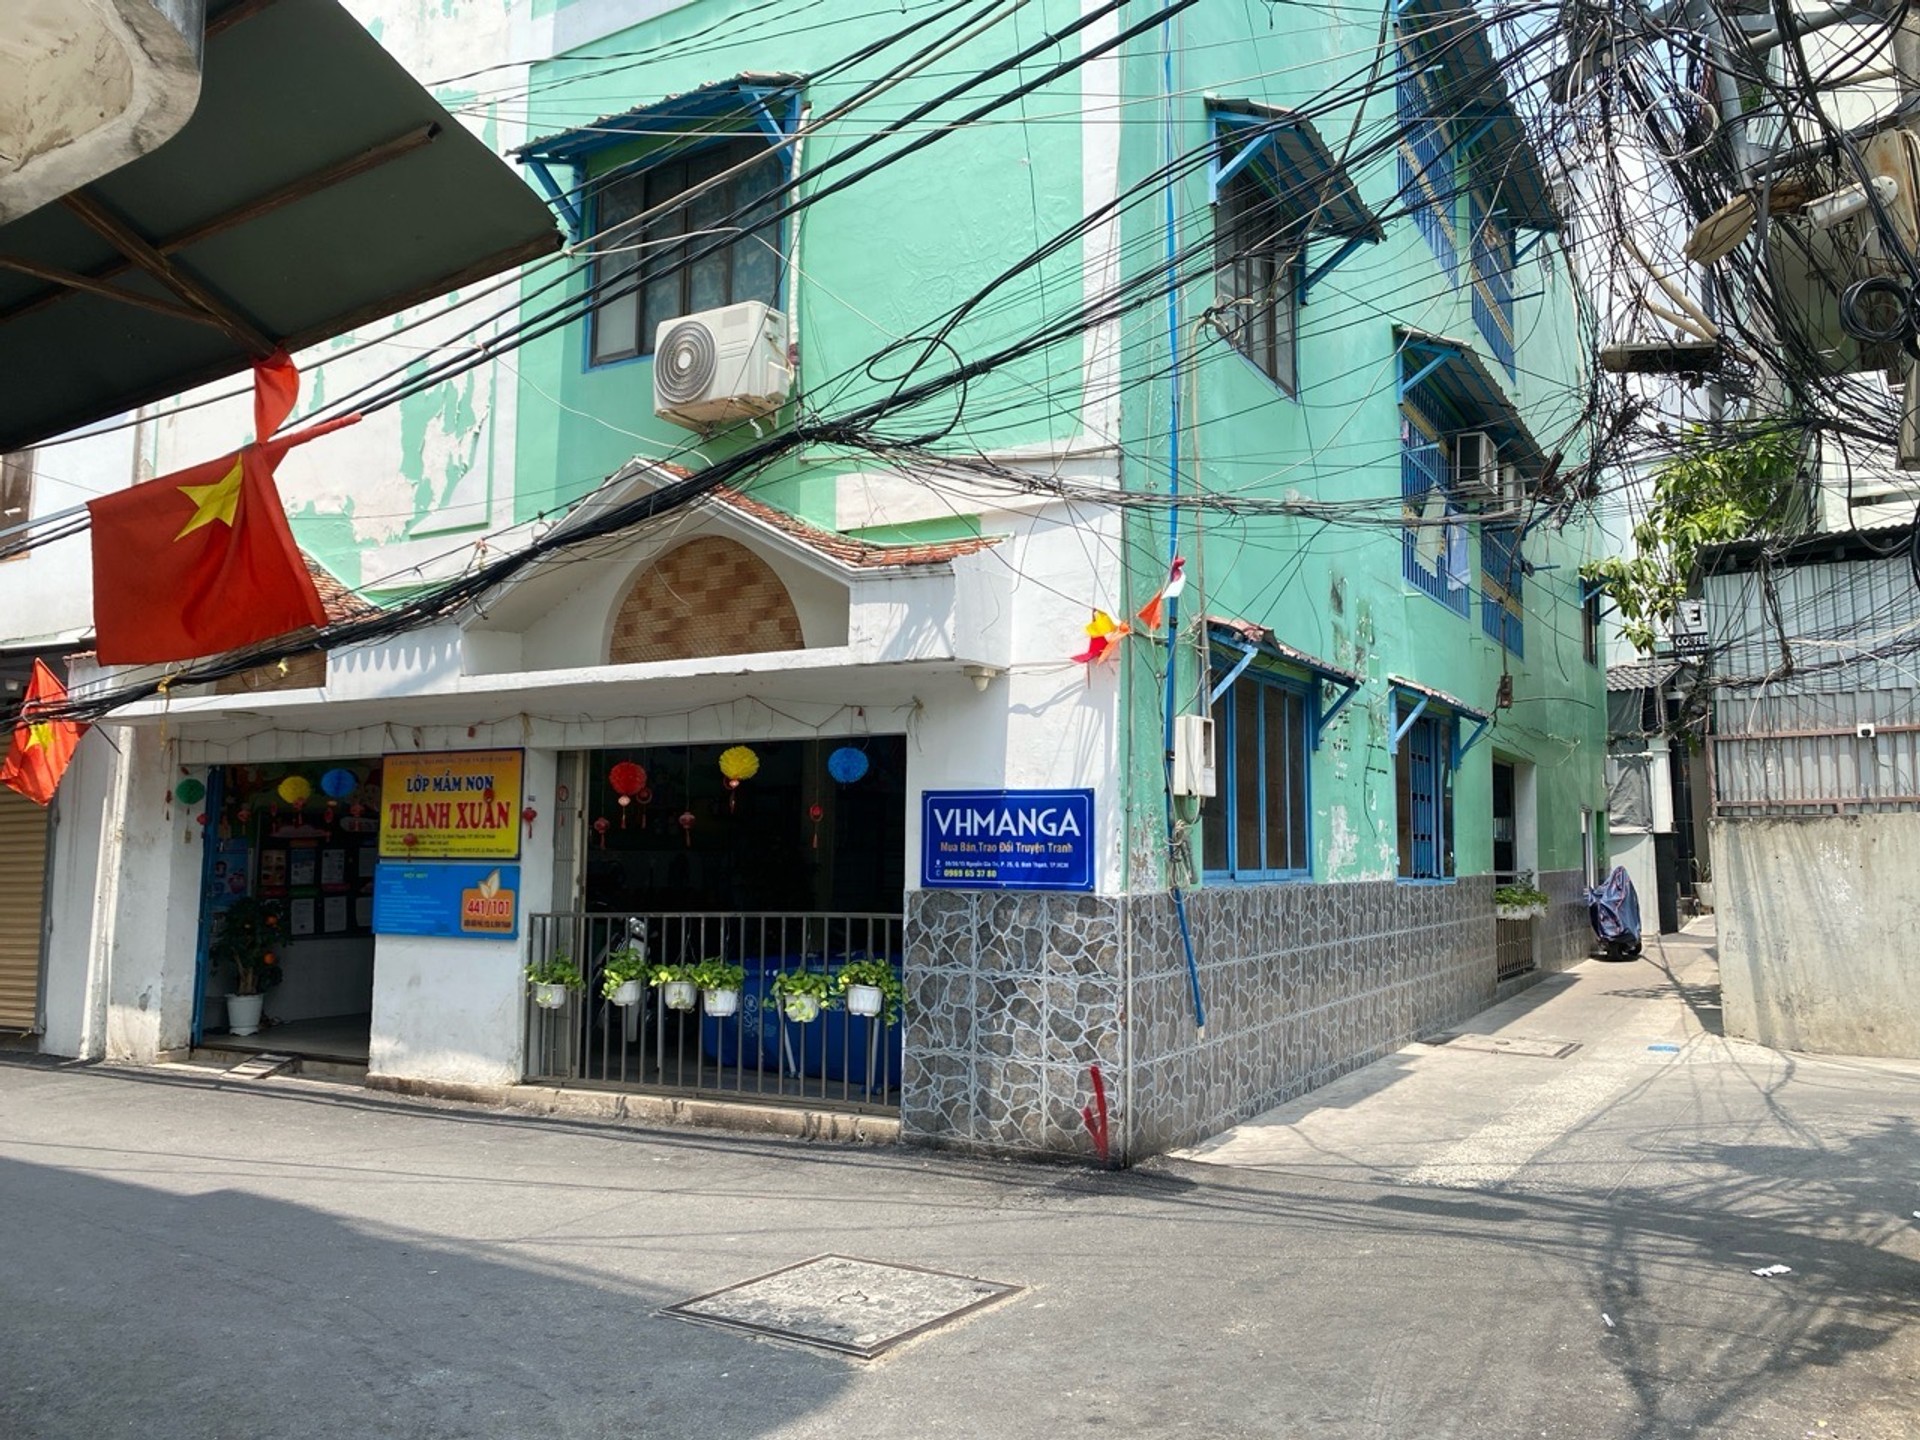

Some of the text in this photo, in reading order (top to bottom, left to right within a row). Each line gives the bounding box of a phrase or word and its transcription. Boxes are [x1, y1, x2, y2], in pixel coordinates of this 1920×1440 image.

[407, 774, 430, 792] LỚP
[466, 776, 494, 791] NON
[389, 802, 451, 829] THANH
[933, 808, 1081, 836] VHMANGA
[940, 841, 958, 852] Mua
[978, 841, 998, 853] Trao
[1015, 841, 1045, 855] Truyện
[1047, 842, 1073, 853] Tranh
[468, 899, 510, 917] 441/101
